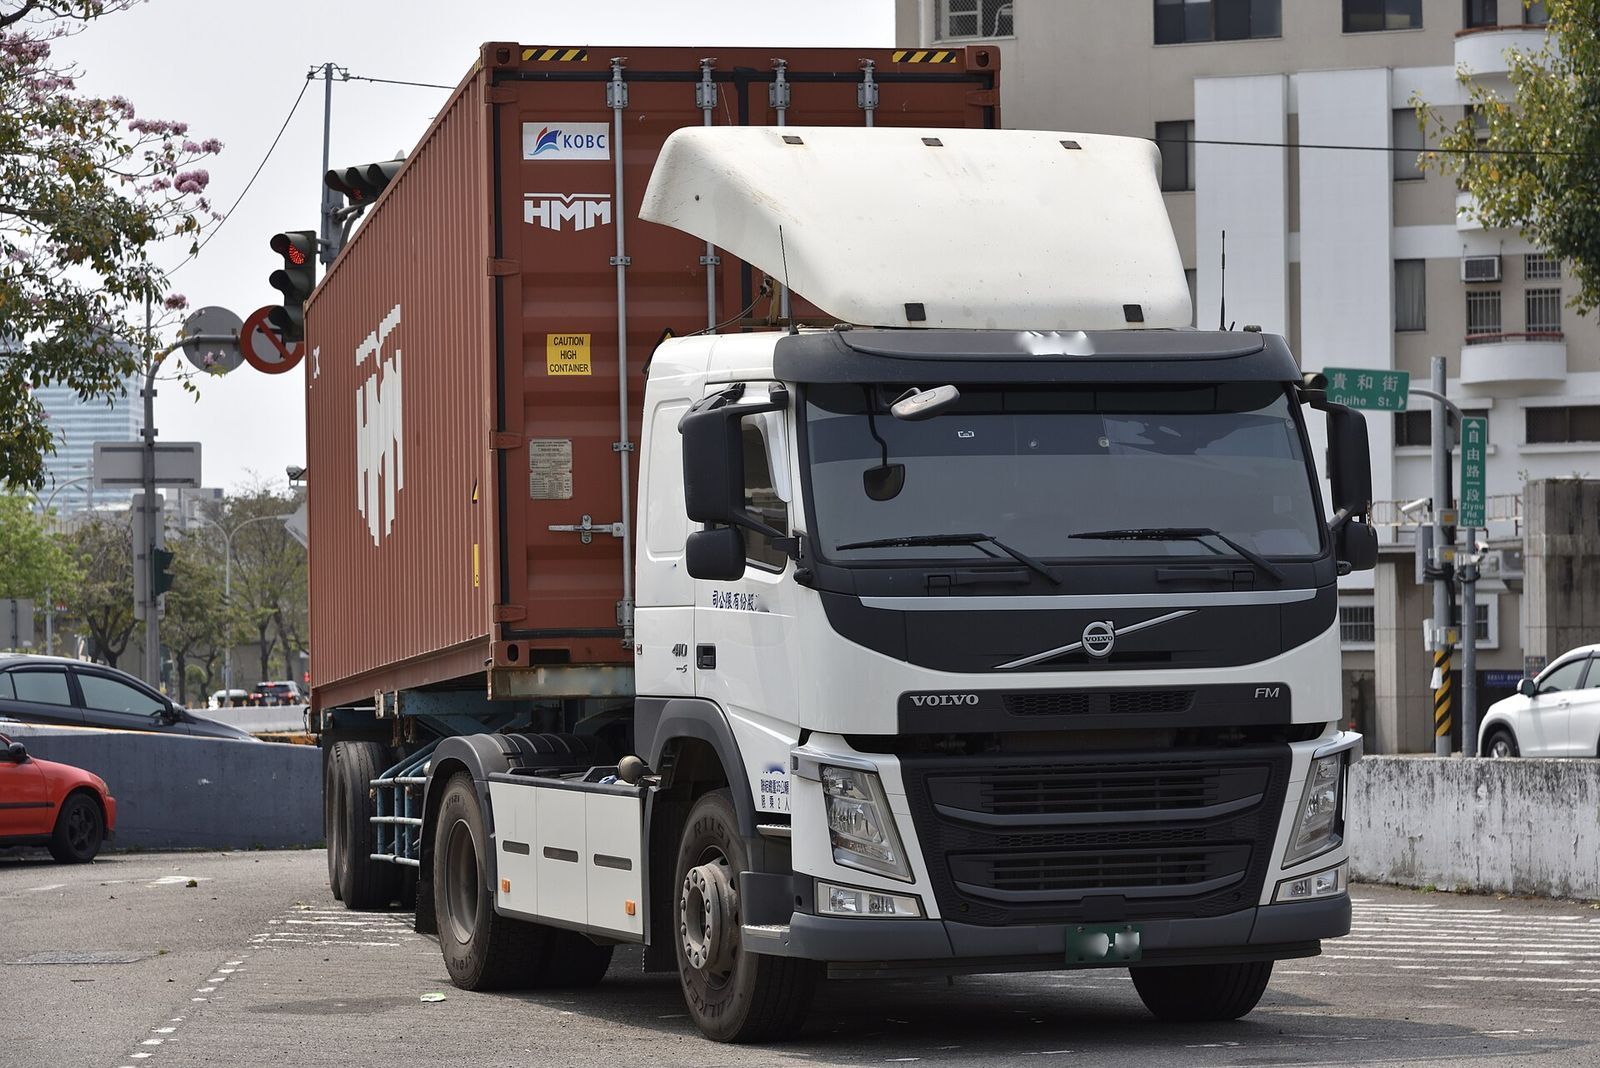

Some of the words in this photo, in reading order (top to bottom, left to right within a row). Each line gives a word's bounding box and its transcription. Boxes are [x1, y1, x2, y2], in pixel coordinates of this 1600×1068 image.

[563, 134, 606, 149] KOBC
[524, 193, 611, 231] HMM
[553, 336, 585, 346] CAUTION
[560, 350, 577, 360] HIGH
[549, 363, 589, 373] CONTAINER
[1332, 372, 1399, 393] 貴和街
[1335, 394, 1367, 407] Guihe
[1377, 396, 1393, 408] St.
[1466, 429, 1480, 502] 自由路一段
[1462, 502, 1484, 511] Ziyou
[671, 643, 688, 658] 410
[1254, 687, 1280, 699] FM
[909, 694, 979, 707] VOLVO
